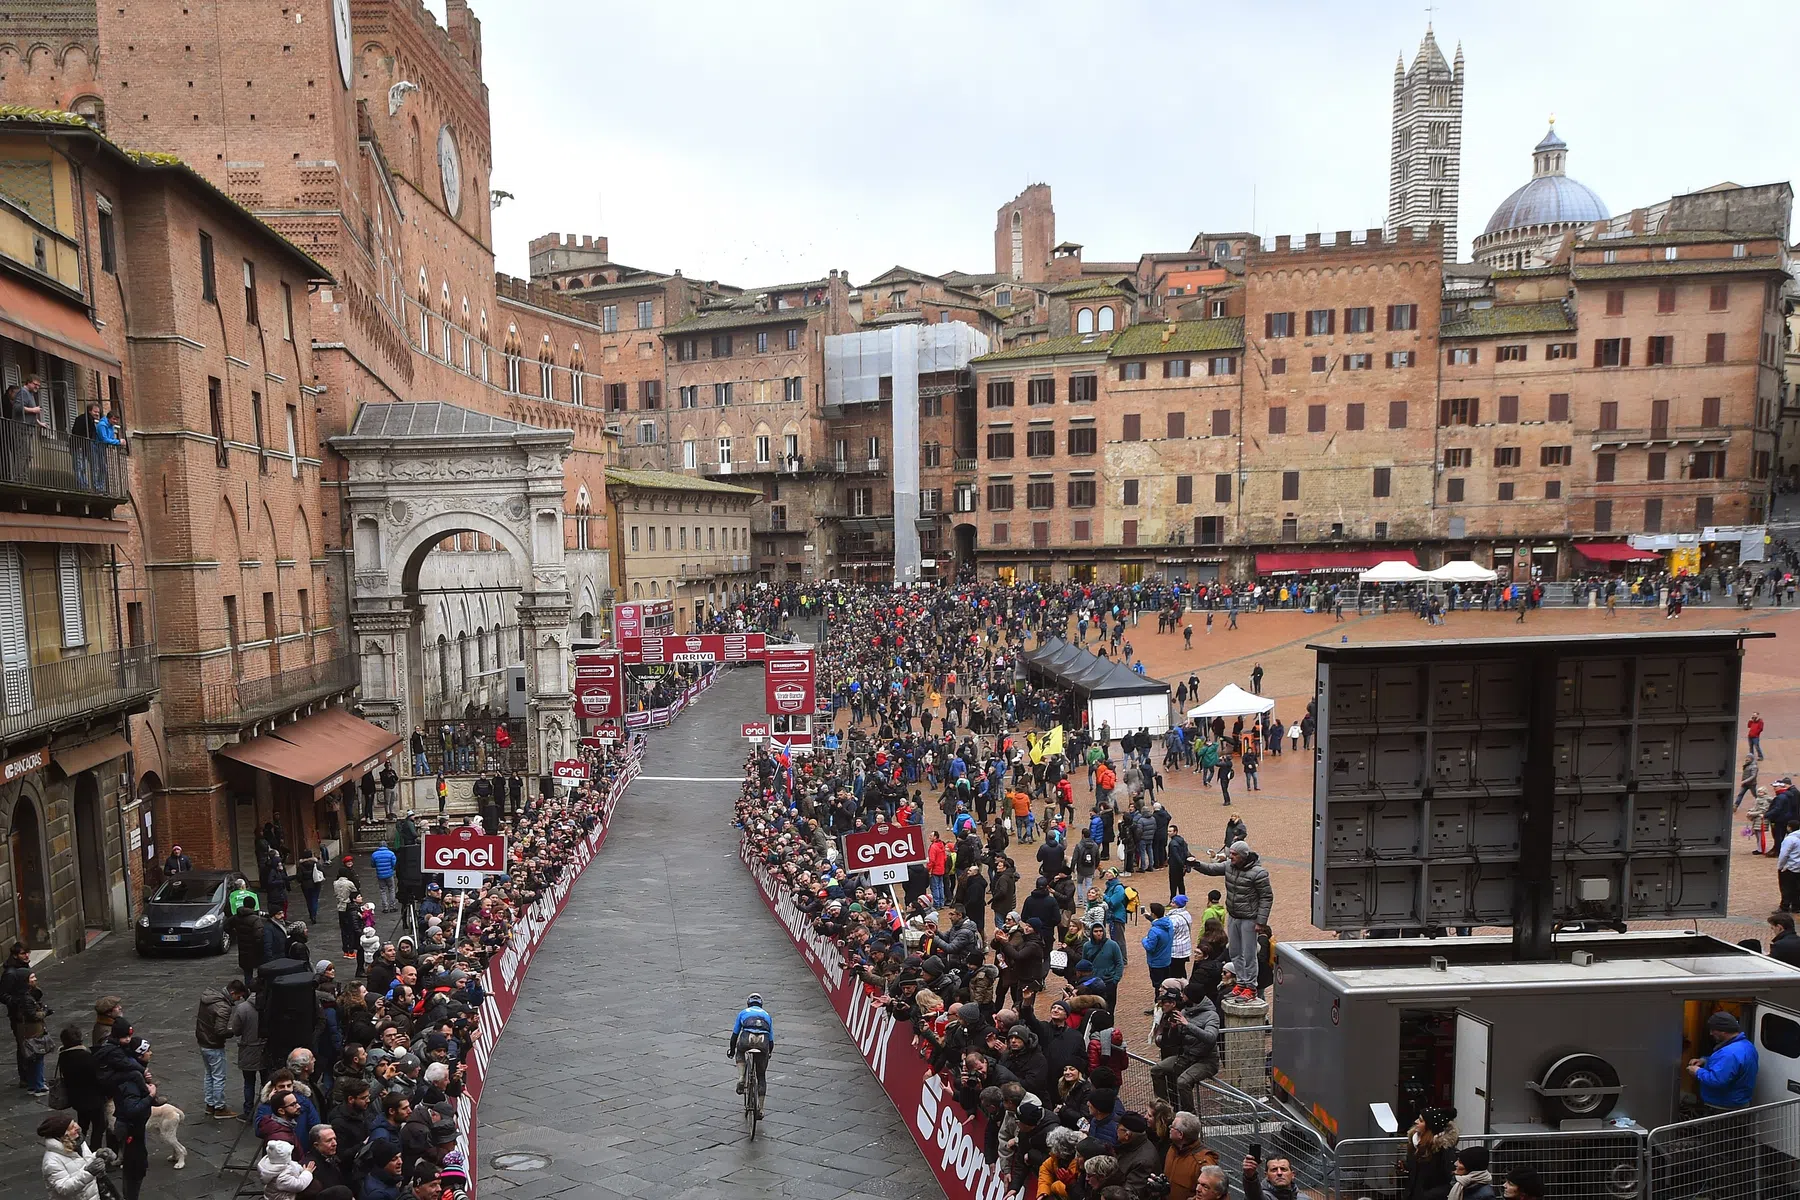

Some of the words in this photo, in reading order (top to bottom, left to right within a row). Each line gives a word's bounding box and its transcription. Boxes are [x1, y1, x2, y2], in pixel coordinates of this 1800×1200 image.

[675, 653, 714, 661] ARRIVO
[648, 665, 665, 675] 1:20
[596, 729, 616, 737] enel
[745, 726, 766, 735] enel
[558, 766, 585, 777] enel
[857, 833, 916, 863] enel
[435, 843, 495, 867] enel
[457, 875, 470, 885] 50
[883, 870, 895, 880] 50
